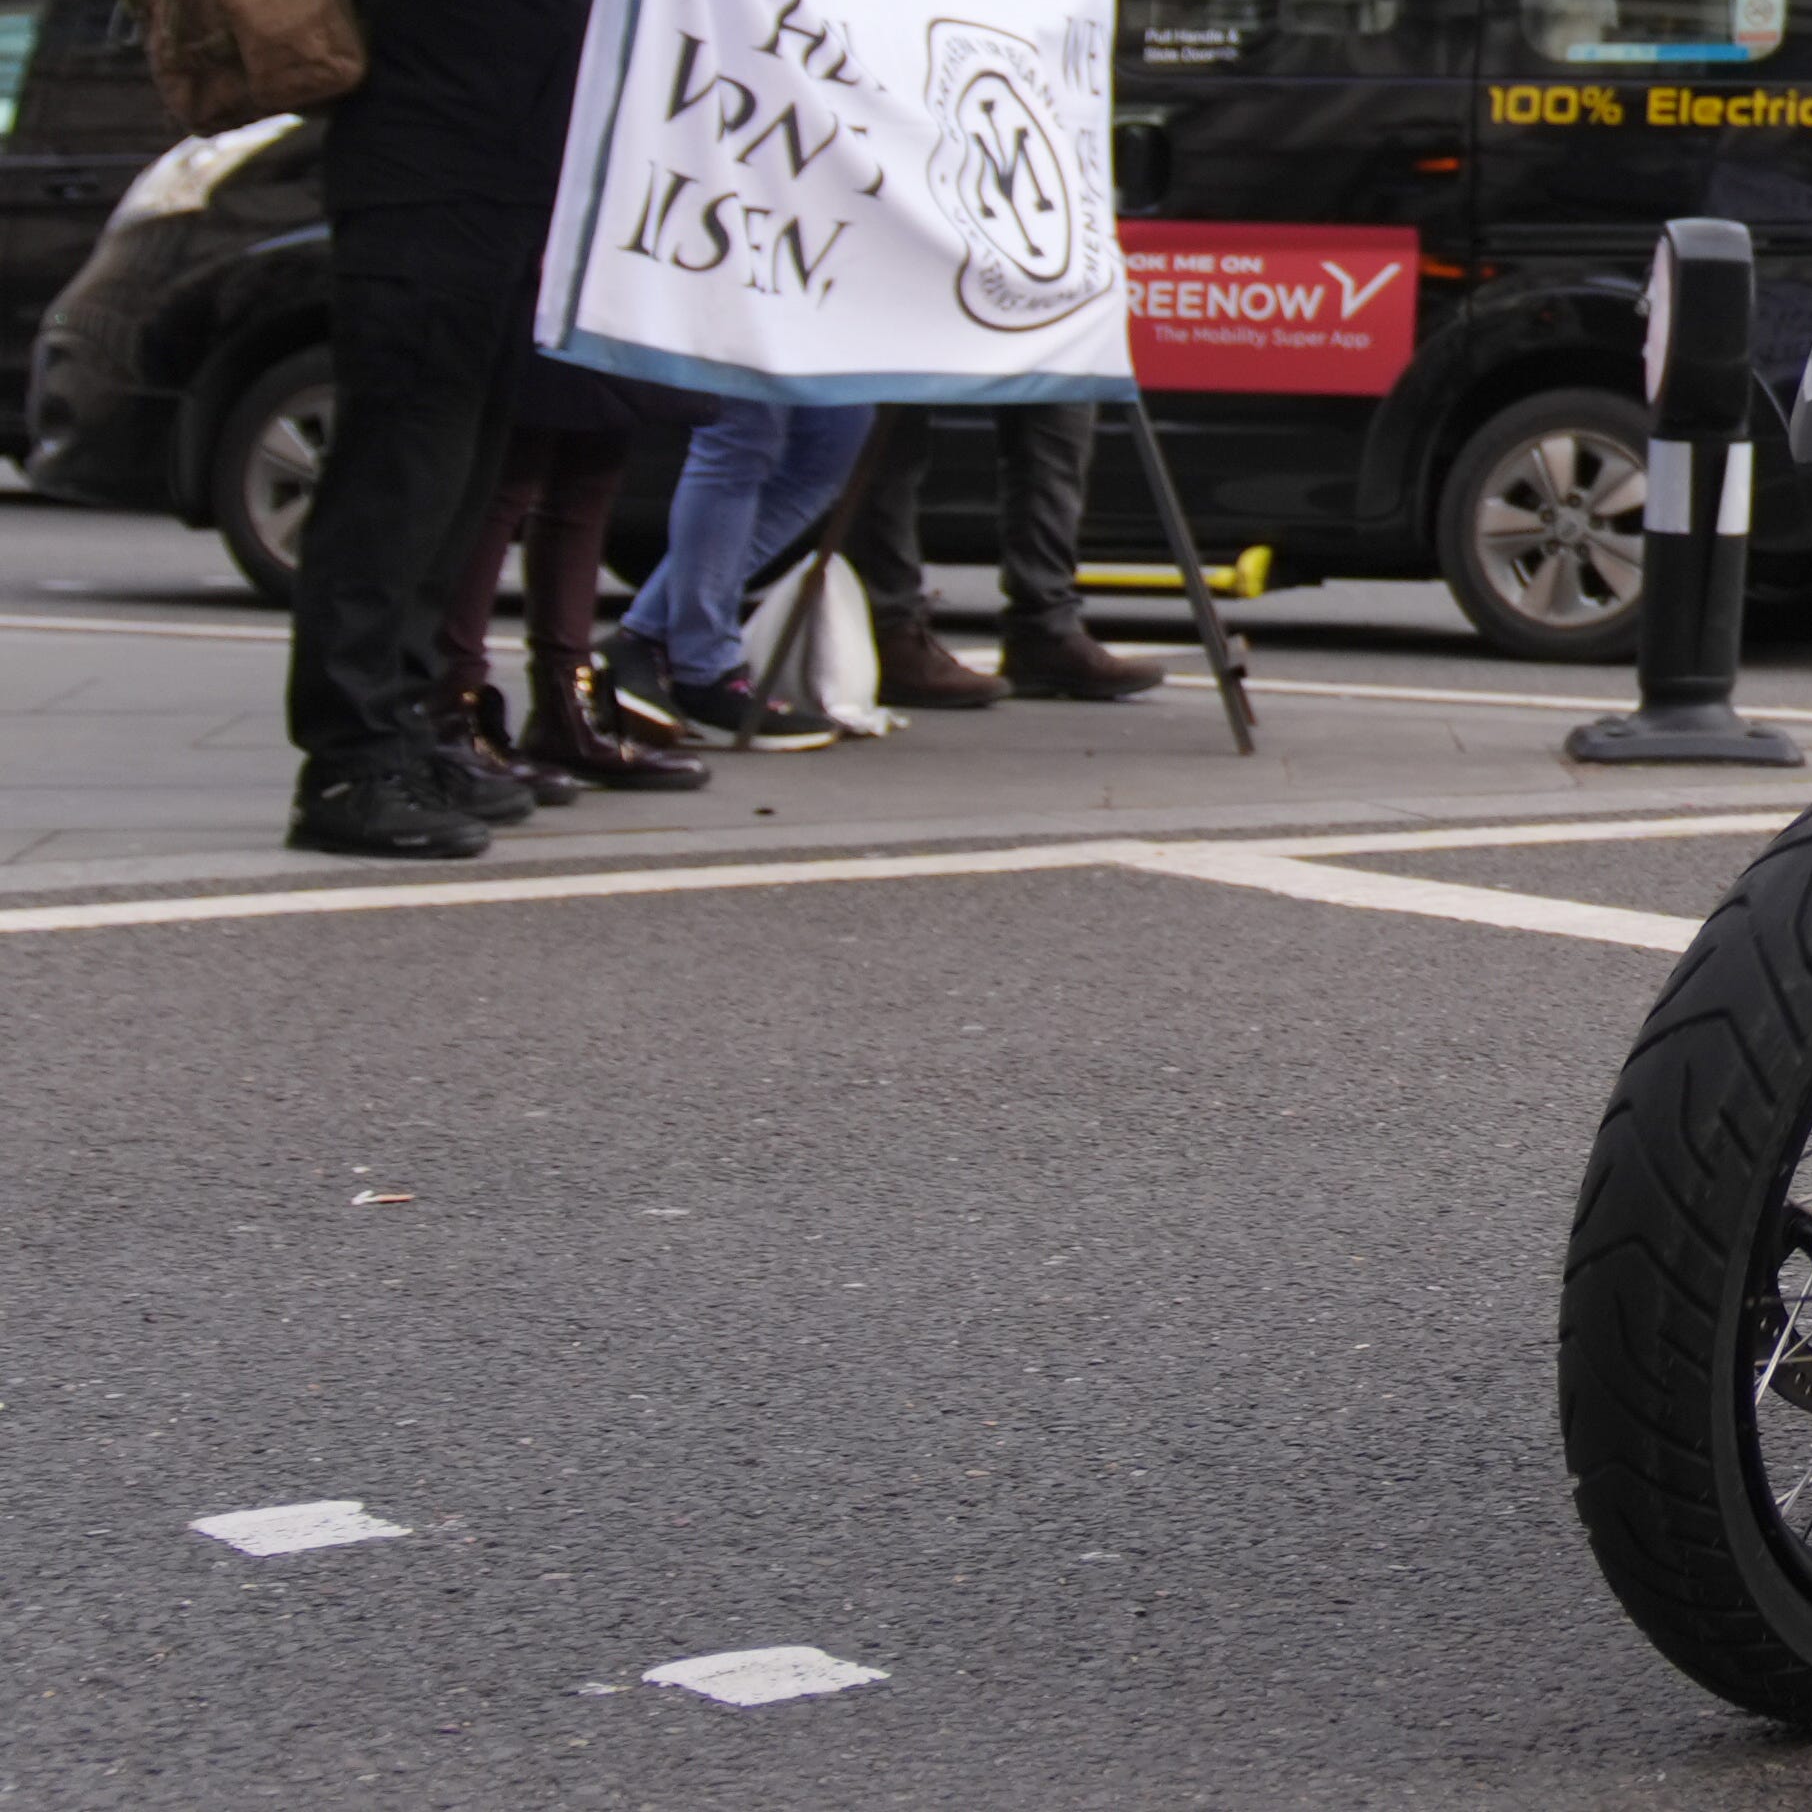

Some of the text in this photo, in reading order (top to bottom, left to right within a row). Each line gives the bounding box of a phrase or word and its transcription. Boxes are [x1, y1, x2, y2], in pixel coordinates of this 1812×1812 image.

[1489, 85, 1623, 125] 100%
[1173, 254, 1216, 273] ME
[1220, 255, 1264, 275] ON
[1126, 281, 1325, 322] REENOW
[1194, 326, 1267, 349] Mobility
[1272, 328, 1326, 348] Super
[1331, 329, 1371, 351] App
